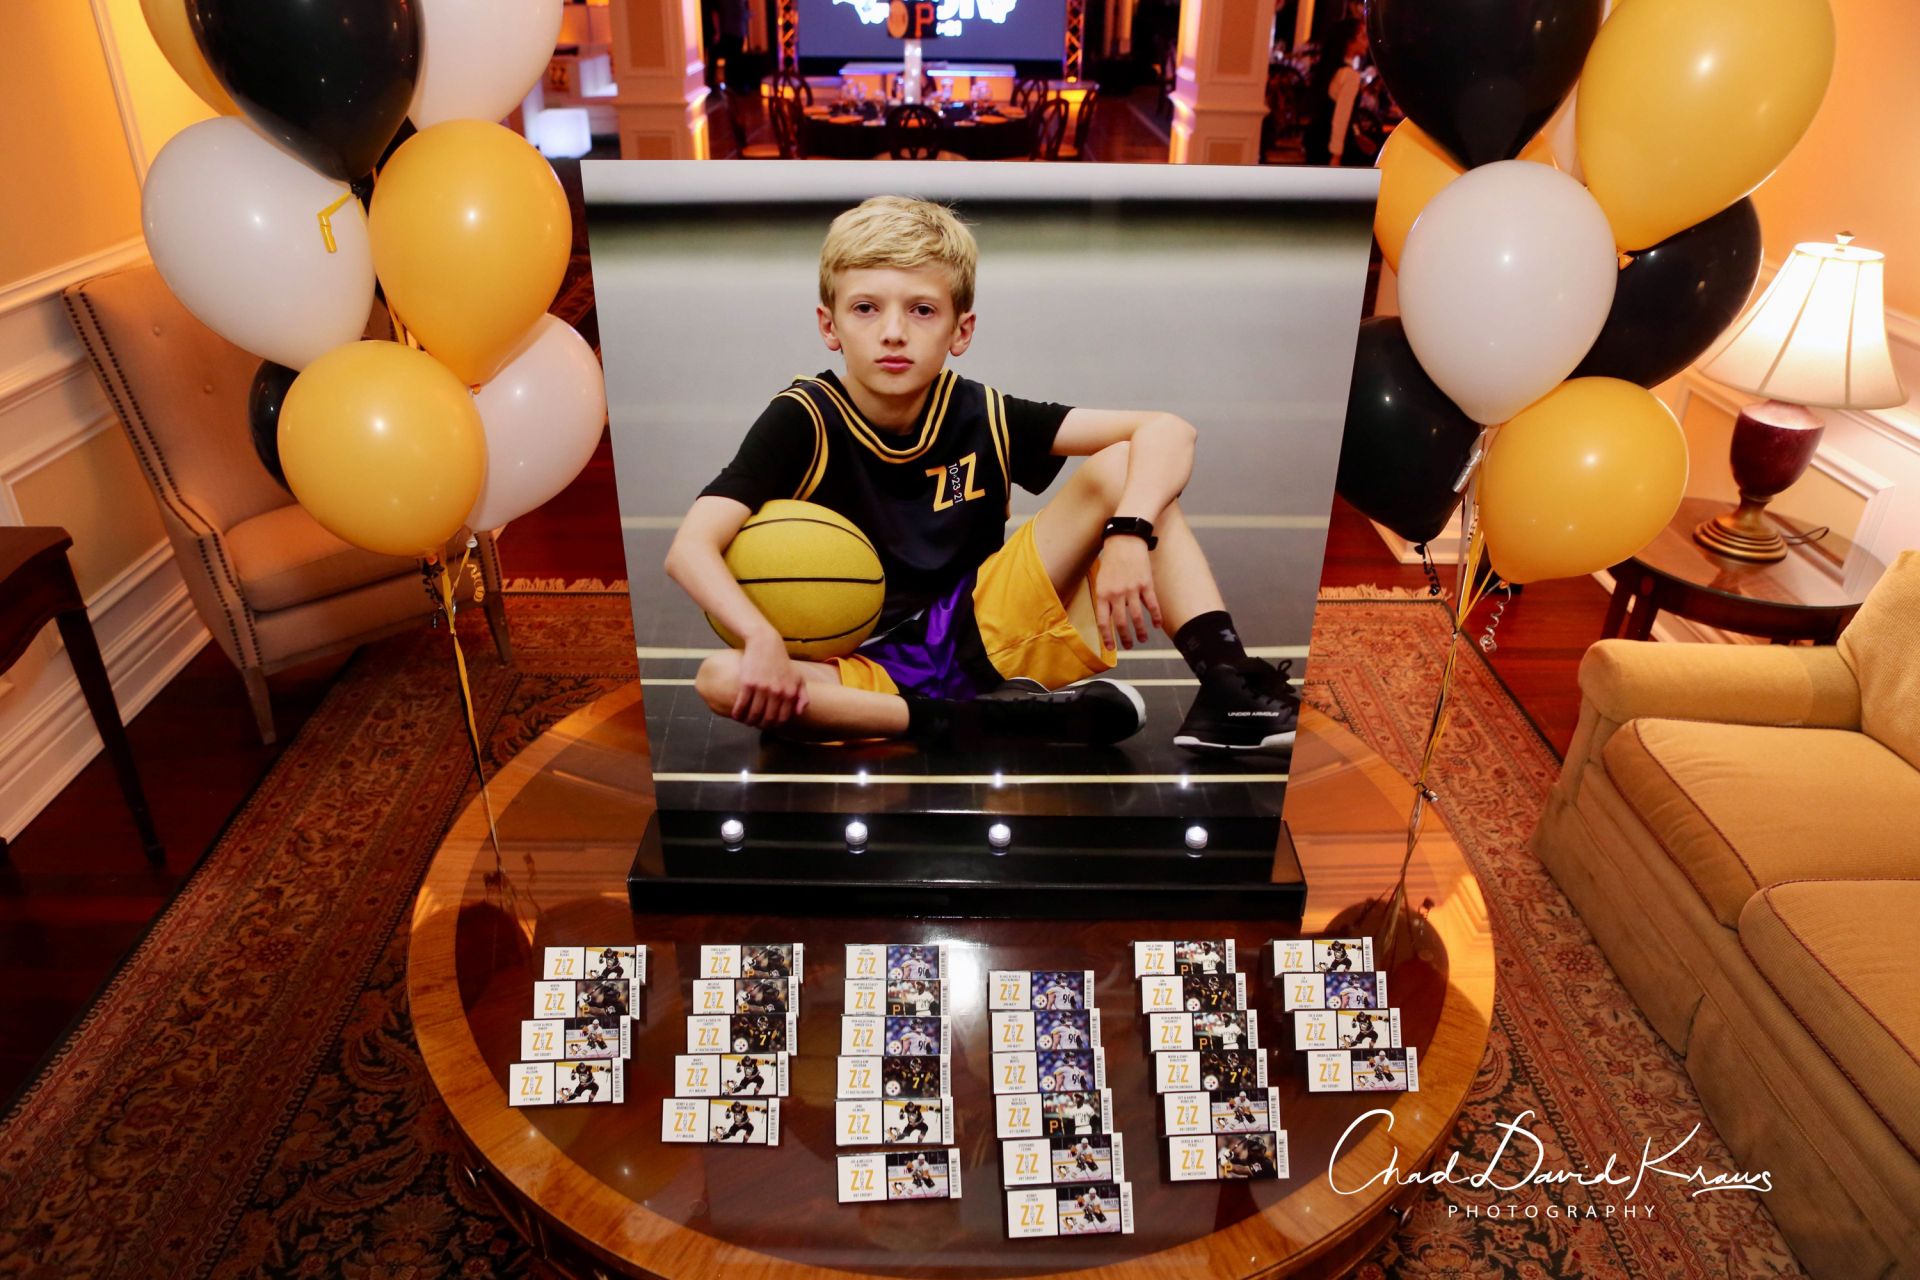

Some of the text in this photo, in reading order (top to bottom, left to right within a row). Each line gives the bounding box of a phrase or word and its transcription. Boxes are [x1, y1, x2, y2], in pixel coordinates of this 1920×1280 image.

[915, 3, 934, 39] P
[925, 451, 986, 513] ZZ
[554, 958, 574, 976] ZZ
[711, 957, 731, 974] ZZ
[857, 957, 876, 975] ZZ
[1145, 953, 1165, 970] ZZ
[1284, 951, 1304, 969] ZZ
[1181, 964, 1189, 975] P
[704, 992, 724, 1009] ZZ
[855, 992, 876, 1009] ZZ
[1000, 983, 1020, 1001] ZZ
[1152, 988, 1173, 1006] ZZ
[1211, 994, 1219, 1006] 7
[1295, 985, 1314, 1003] ZZ
[544, 993, 565, 1011] ZZ
[892, 1004, 901, 1015] P
[698, 1028, 719, 1046] ZZ
[759, 1034, 768, 1046] 7
[852, 1029, 874, 1047] ZZ
[1003, 1024, 1024, 1043] ZZ
[1161, 1025, 1182, 1044] ZZ
[1306, 1023, 1326, 1041] ZZ
[532, 1032, 554, 1051] ZZ
[1200, 1038, 1208, 1050] P
[687, 1068, 708, 1087] ZZ
[848, 1069, 871, 1088] ZZ
[1004, 1065, 1026, 1085] ZZ
[1167, 1064, 1189, 1083] ZZ
[1230, 1072, 1238, 1083] 7
[1319, 1063, 1340, 1082] ZZ
[520, 1076, 543, 1096] ZZ
[912, 1077, 920, 1089] 7
[674, 1112, 697, 1132] ZZ
[848, 1114, 870, 1134] ZZ
[1008, 1107, 1031, 1128] ZZ
[1176, 1105, 1199, 1125] ZZ
[1049, 1120, 1059, 1133] P
[1016, 1153, 1039, 1175] ZZ
[1182, 1149, 1205, 1170] ZZ
[850, 1169, 874, 1191] ZZ
[1020, 1204, 1045, 1226] ZZ
